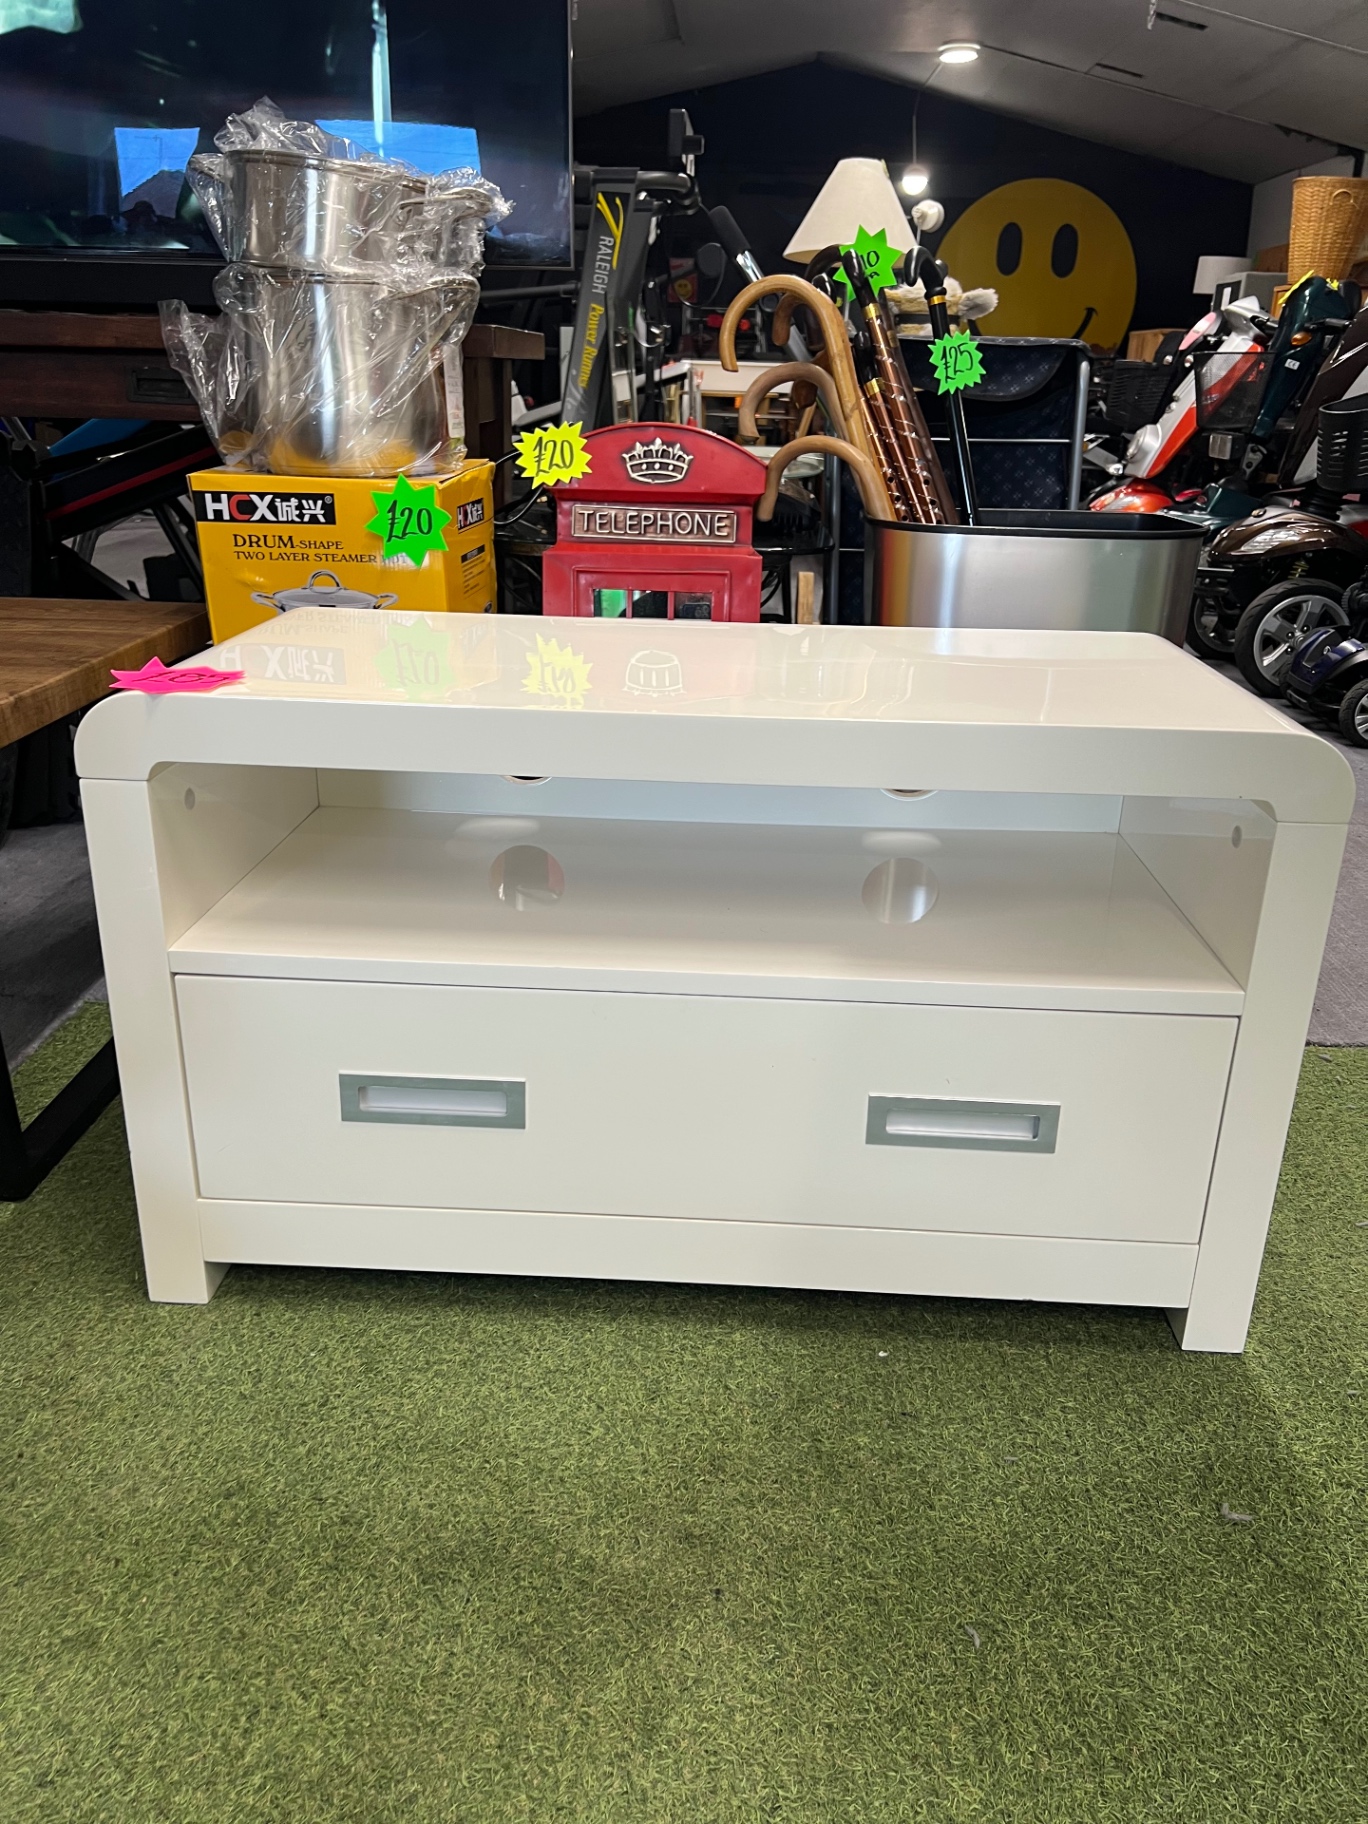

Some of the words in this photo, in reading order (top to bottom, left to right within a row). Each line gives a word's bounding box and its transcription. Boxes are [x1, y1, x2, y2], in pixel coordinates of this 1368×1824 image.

[591, 235, 615, 294] RALEIGH
[585, 303, 605, 345] Power
[940, 342, 974, 384] £25
[532, 436, 575, 477] £20
[386, 499, 433, 543] £20
[578, 510, 729, 537] TELEPHONE
[233, 551, 266, 561] TWO
[268, 552, 310, 562] LAYER
[314, 553, 377, 564] STEAMER
